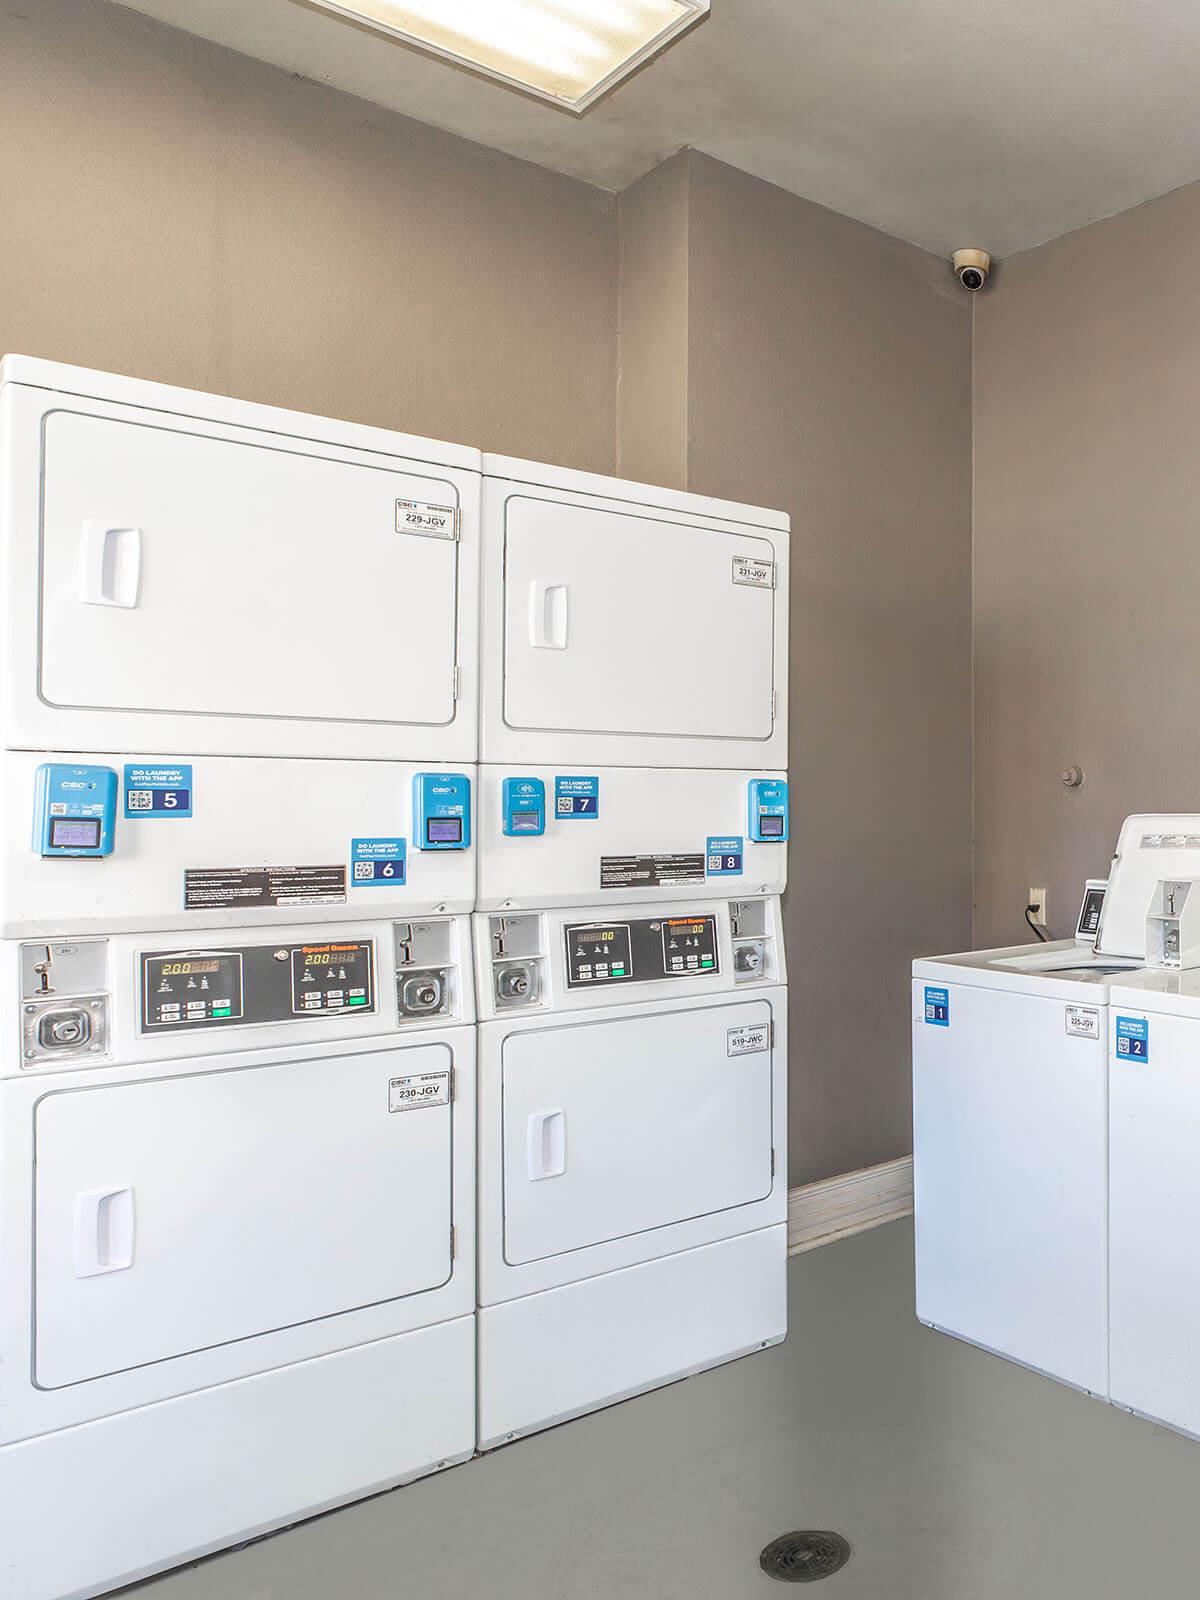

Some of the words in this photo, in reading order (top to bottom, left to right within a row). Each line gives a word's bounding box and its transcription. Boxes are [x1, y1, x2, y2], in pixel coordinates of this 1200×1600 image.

[406, 513, 446, 526] 229-JGV
[739, 568, 767, 578] 231-JGV
[132, 769, 146, 777] DO
[146, 769, 181, 777] LAUNDRY
[61, 781, 85, 789] CSC
[163, 792, 178, 808] 5
[580, 799, 590, 811] 7
[727, 857, 735, 869] 8
[382, 862, 395, 877] 6
[302, 946, 329, 954] Speed
[305, 954, 330, 965] 2.00
[162, 963, 191, 975] 2.00
[939, 1007, 944, 1019] 1
[1133, 1041, 1142, 1054] 2
[399, 1085, 440, 1099] 230-JGV
